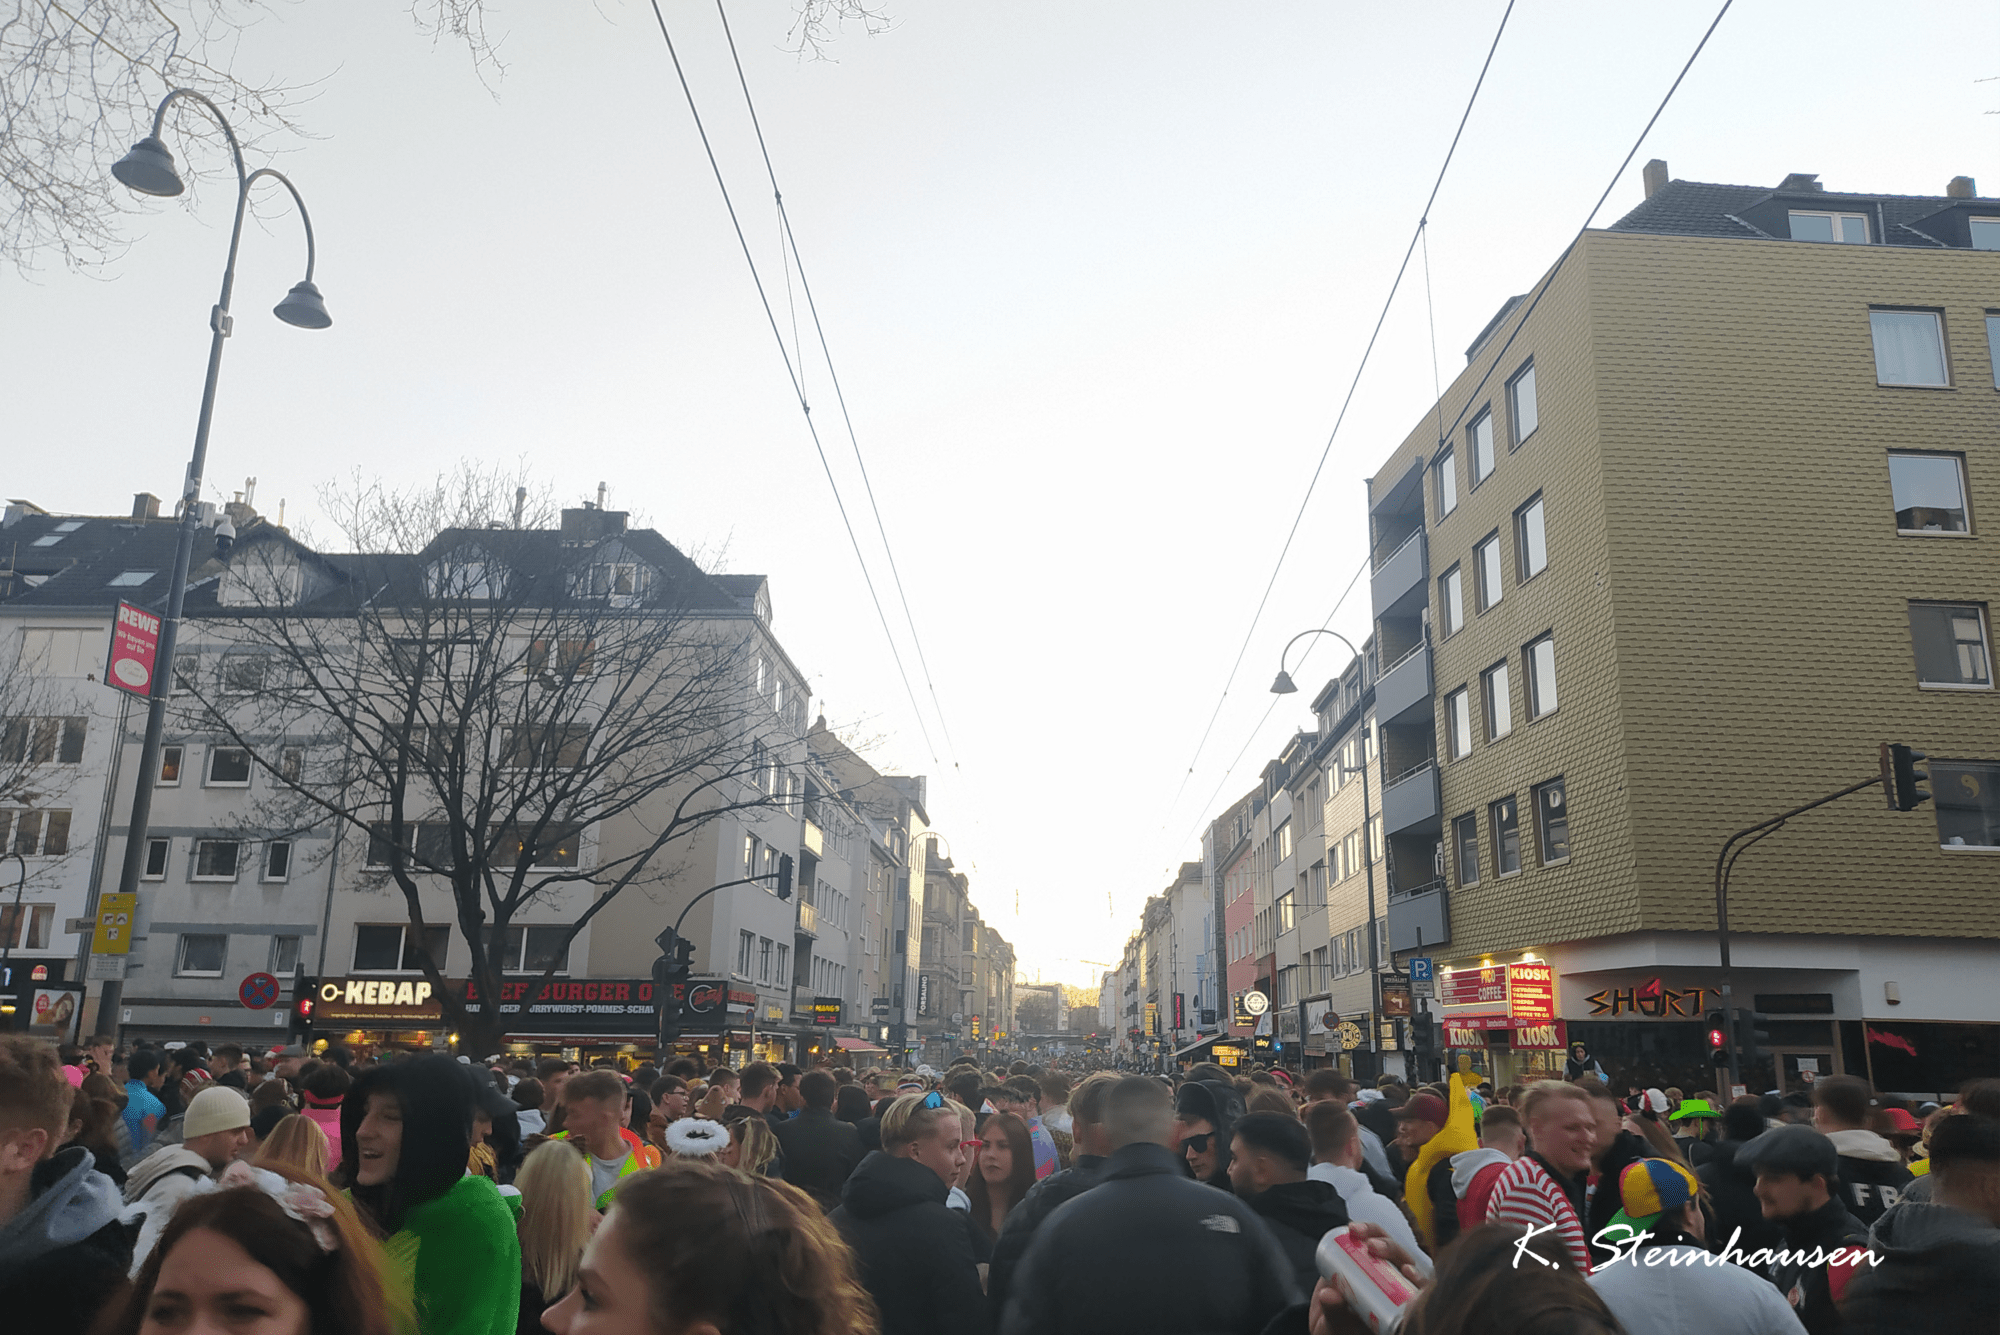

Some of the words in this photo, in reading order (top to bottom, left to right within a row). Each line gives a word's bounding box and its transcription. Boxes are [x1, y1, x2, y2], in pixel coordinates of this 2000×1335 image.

[119, 606, 160, 635] REWE
[1414, 960, 1427, 978] P
[1510, 967, 1551, 981] KIOSK
[344, 980, 432, 1006] KEBAP
[638, 983, 685, 1001] OE
[1478, 986, 1502, 1000] COFFEE
[1584, 978, 1721, 1017] SHORT
[1256, 1038, 1270, 1049] sky
[1449, 1028, 1484, 1046] KIOSK
[1517, 1025, 1560, 1046] KIOSK
